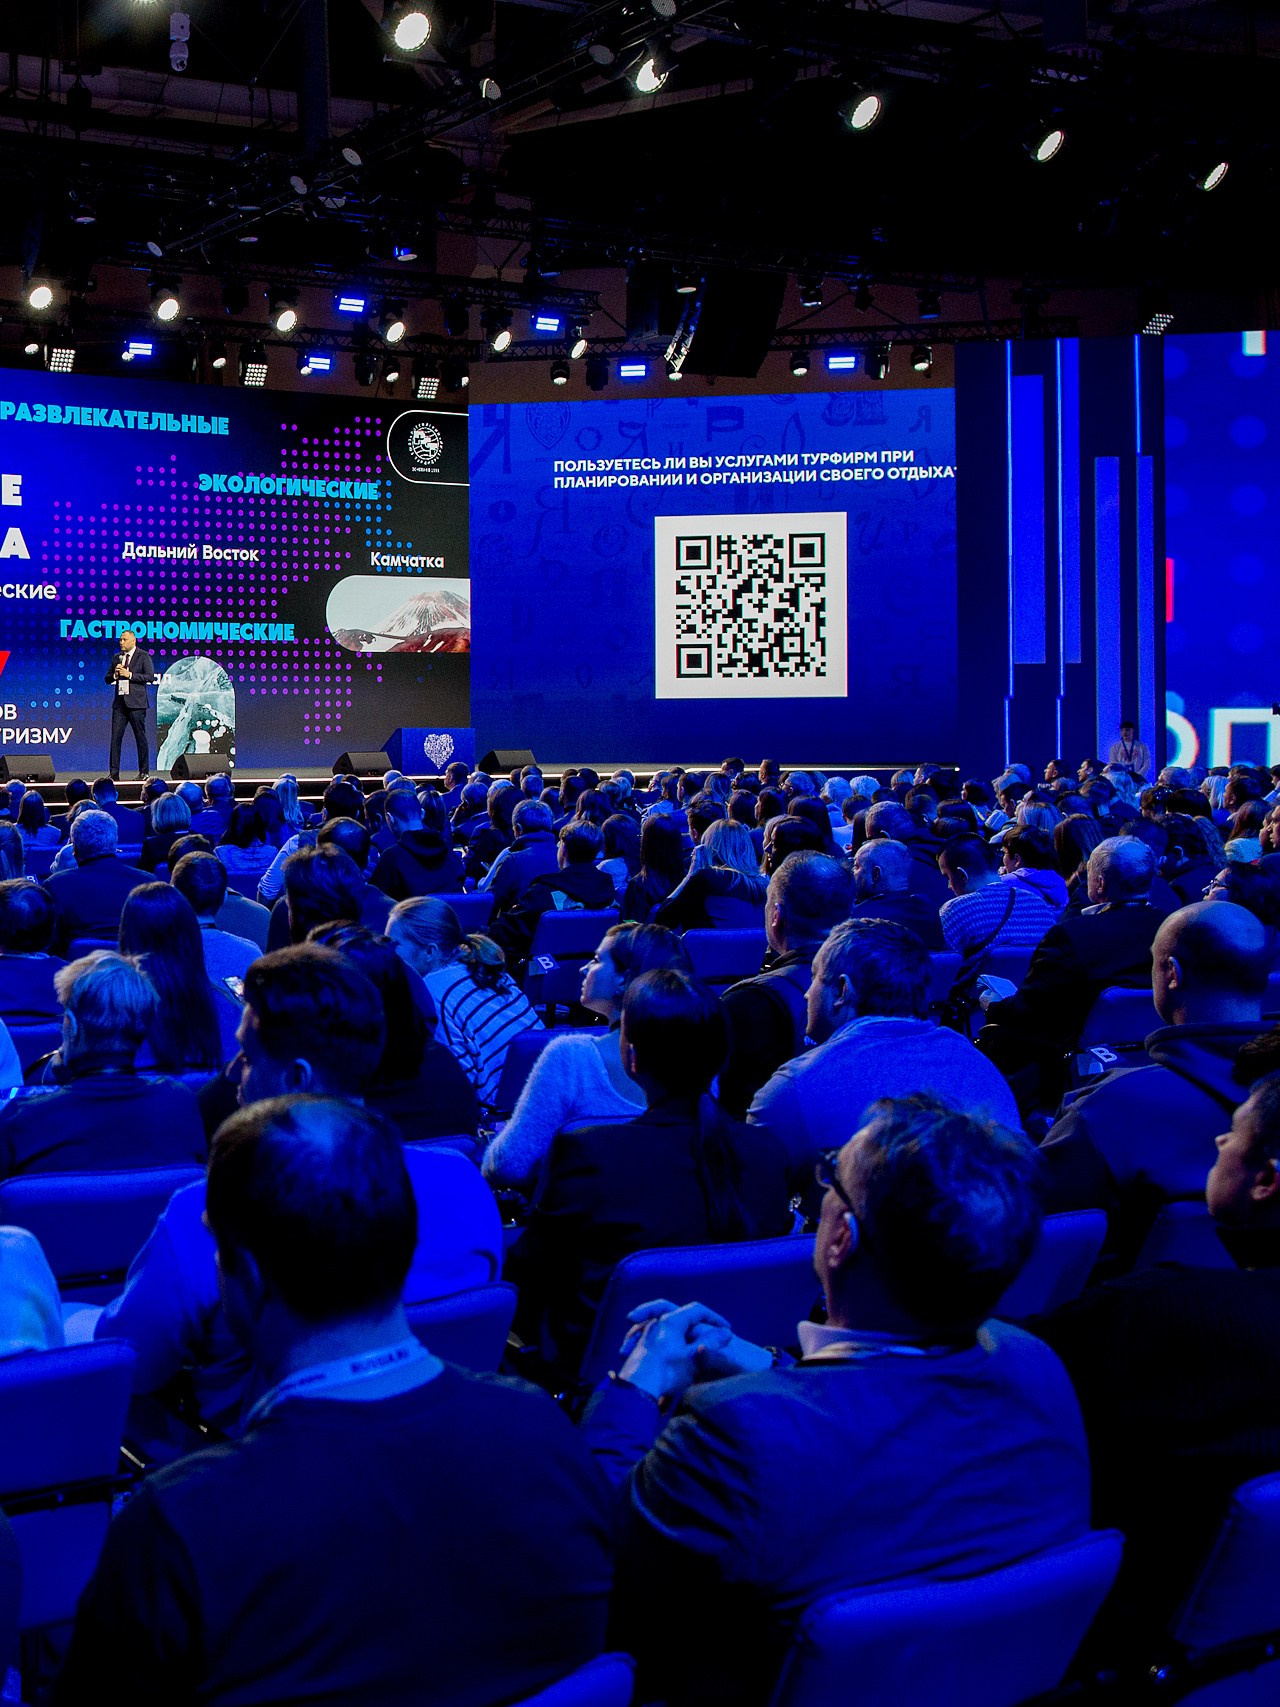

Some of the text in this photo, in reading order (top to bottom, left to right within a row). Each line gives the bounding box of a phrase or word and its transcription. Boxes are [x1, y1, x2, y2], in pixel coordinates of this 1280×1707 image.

[0, 400, 229, 435] РАЗВЛЕКАТЕЛЬНЫЕ
[553, 449, 914, 473] ПОЛЬЗУЕТЕСЬ ЛИ ВЫ УСЛУГАМИ ТУРФИРМ ПРИ
[198, 473, 379, 500] ЭКОЛОГИЧЕСКИЕ
[554, 473, 683, 489] ПЛАНИРОВАНИИ
[686, 473, 698, 485] И
[700, 469, 817, 485] ОРГАНИЗАЦИИ
[820, 467, 885, 482] СВОЕГО
[121, 541, 260, 562] Дальний Восток
[370, 551, 445, 569] Камчатка
[59, 619, 295, 641] ГАСТРОНОМИЧЕСКИЕ
